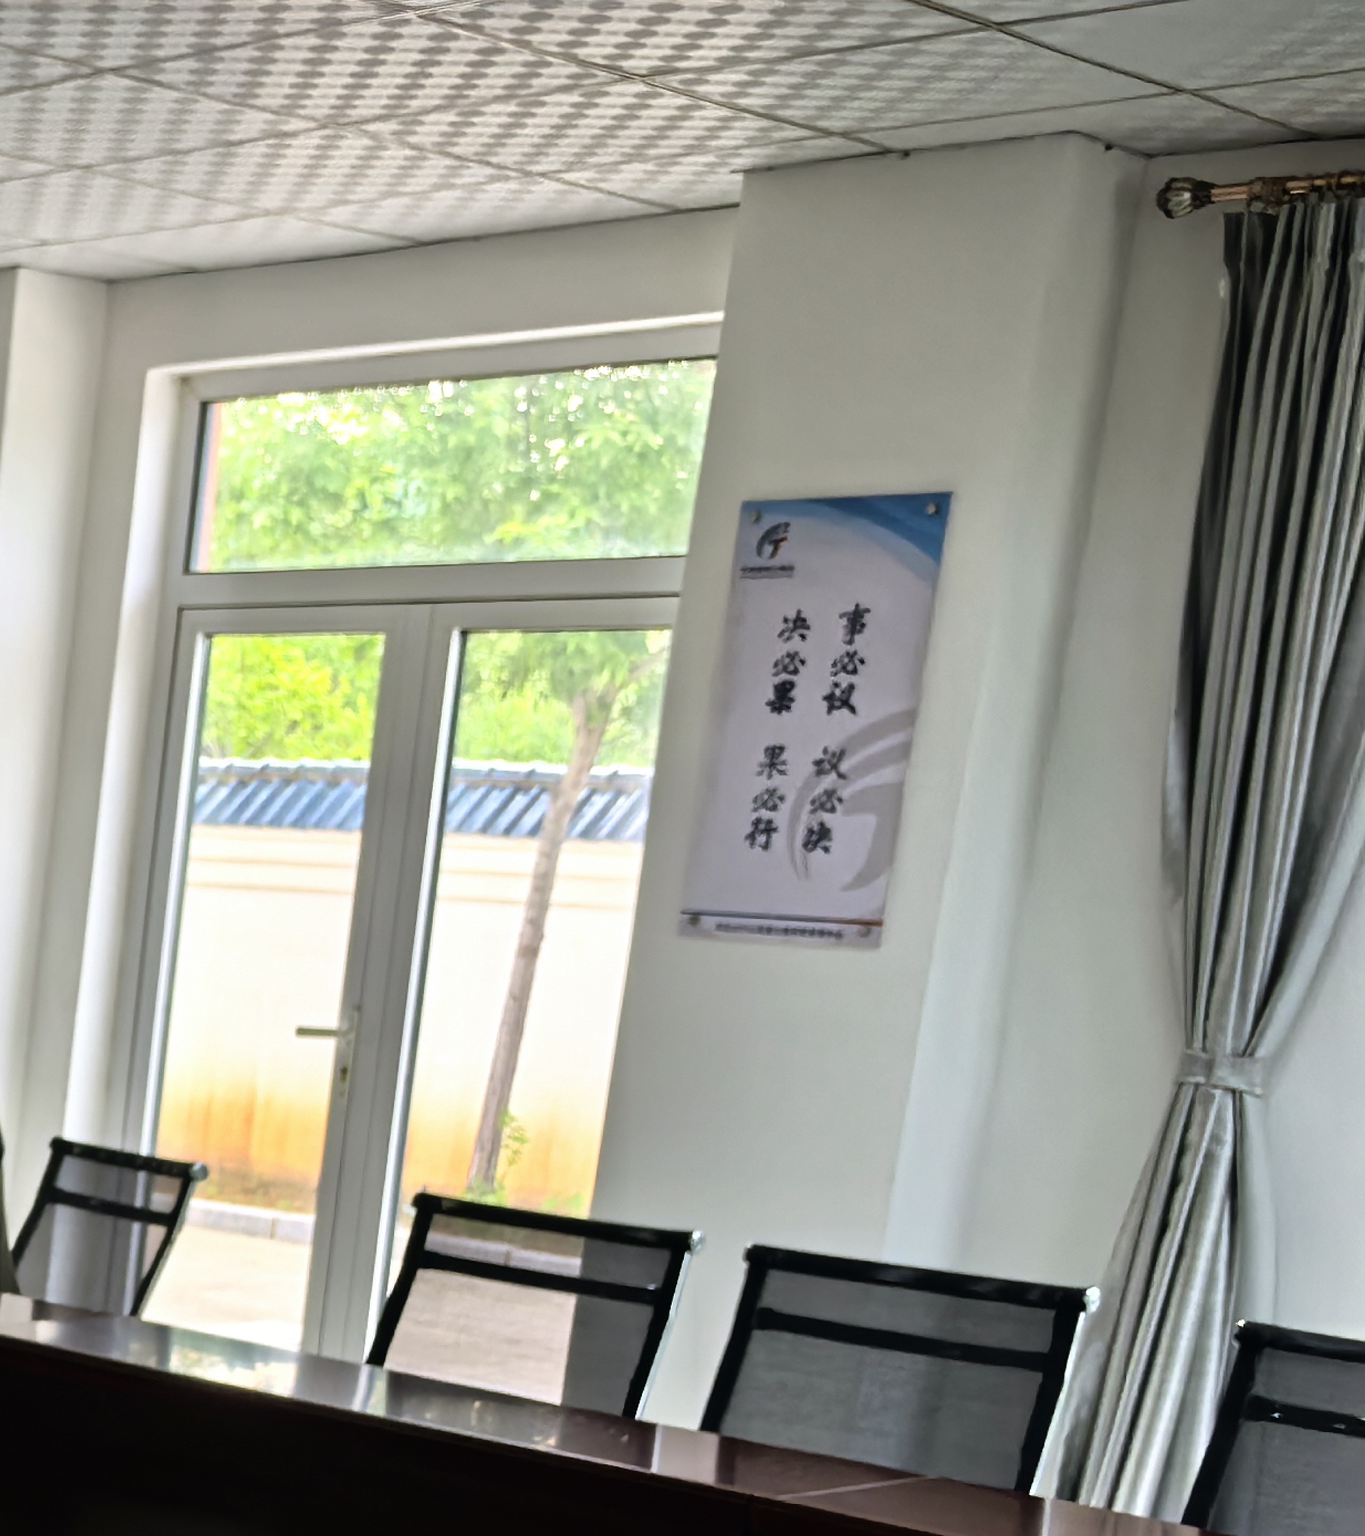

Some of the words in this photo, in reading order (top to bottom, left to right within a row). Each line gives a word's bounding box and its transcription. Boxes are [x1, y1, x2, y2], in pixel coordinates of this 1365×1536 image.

[765, 609, 810, 716] 决必果
[822, 603, 871, 716] 事必议
[744, 744, 788, 852] 果必行
[801, 745, 848, 855] 议必决
